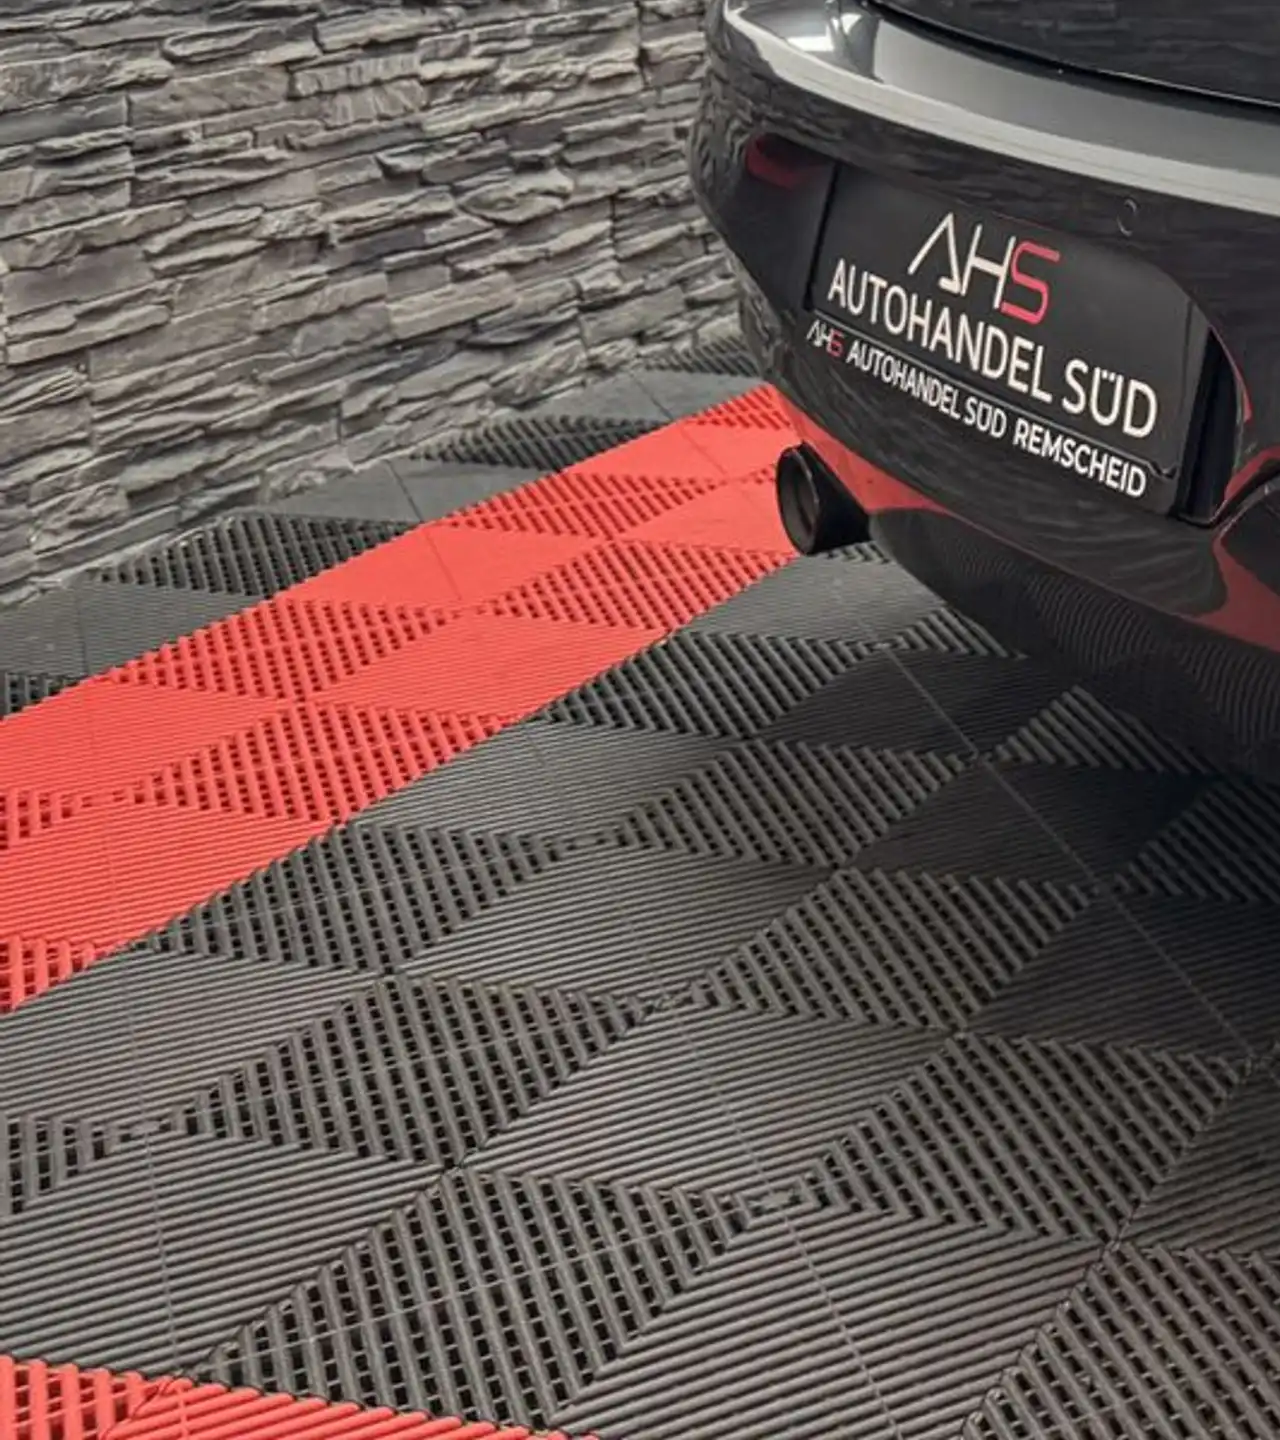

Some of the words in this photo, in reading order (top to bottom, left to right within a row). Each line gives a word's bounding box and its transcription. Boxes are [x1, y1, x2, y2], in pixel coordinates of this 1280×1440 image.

[827, 258, 1053, 404] AUTOHANDEL
[1061, 358, 1159, 440] SÜD
[907, 211, 1061, 325] AHS
[805, 319, 846, 358] AHS
[845, 340, 962, 421] AUTOHANDEL
[963, 396, 1007, 440] SÜD
[1012, 417, 1147, 499] REMSCHEID
